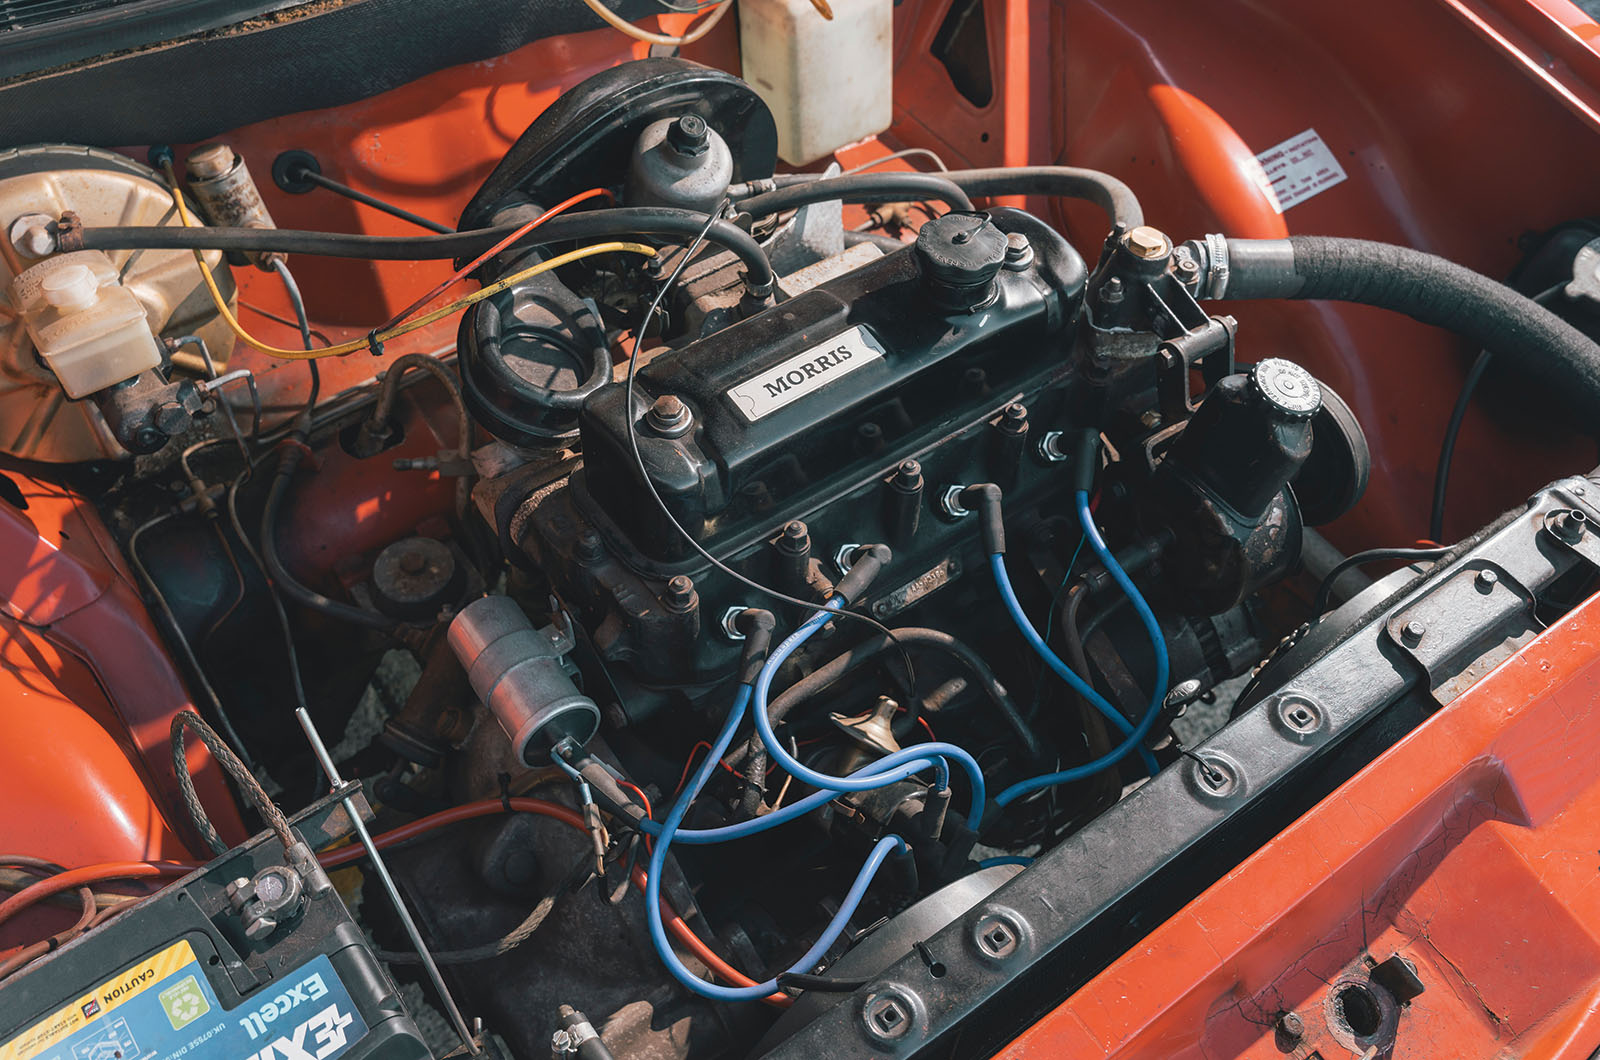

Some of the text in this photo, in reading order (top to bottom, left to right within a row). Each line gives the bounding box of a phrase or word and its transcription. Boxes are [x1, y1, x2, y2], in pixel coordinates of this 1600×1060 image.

[763, 345, 853, 398] MORRIS
[103, 967, 155, 1004] CAUTION
[239, 972, 329, 1040] Excell
